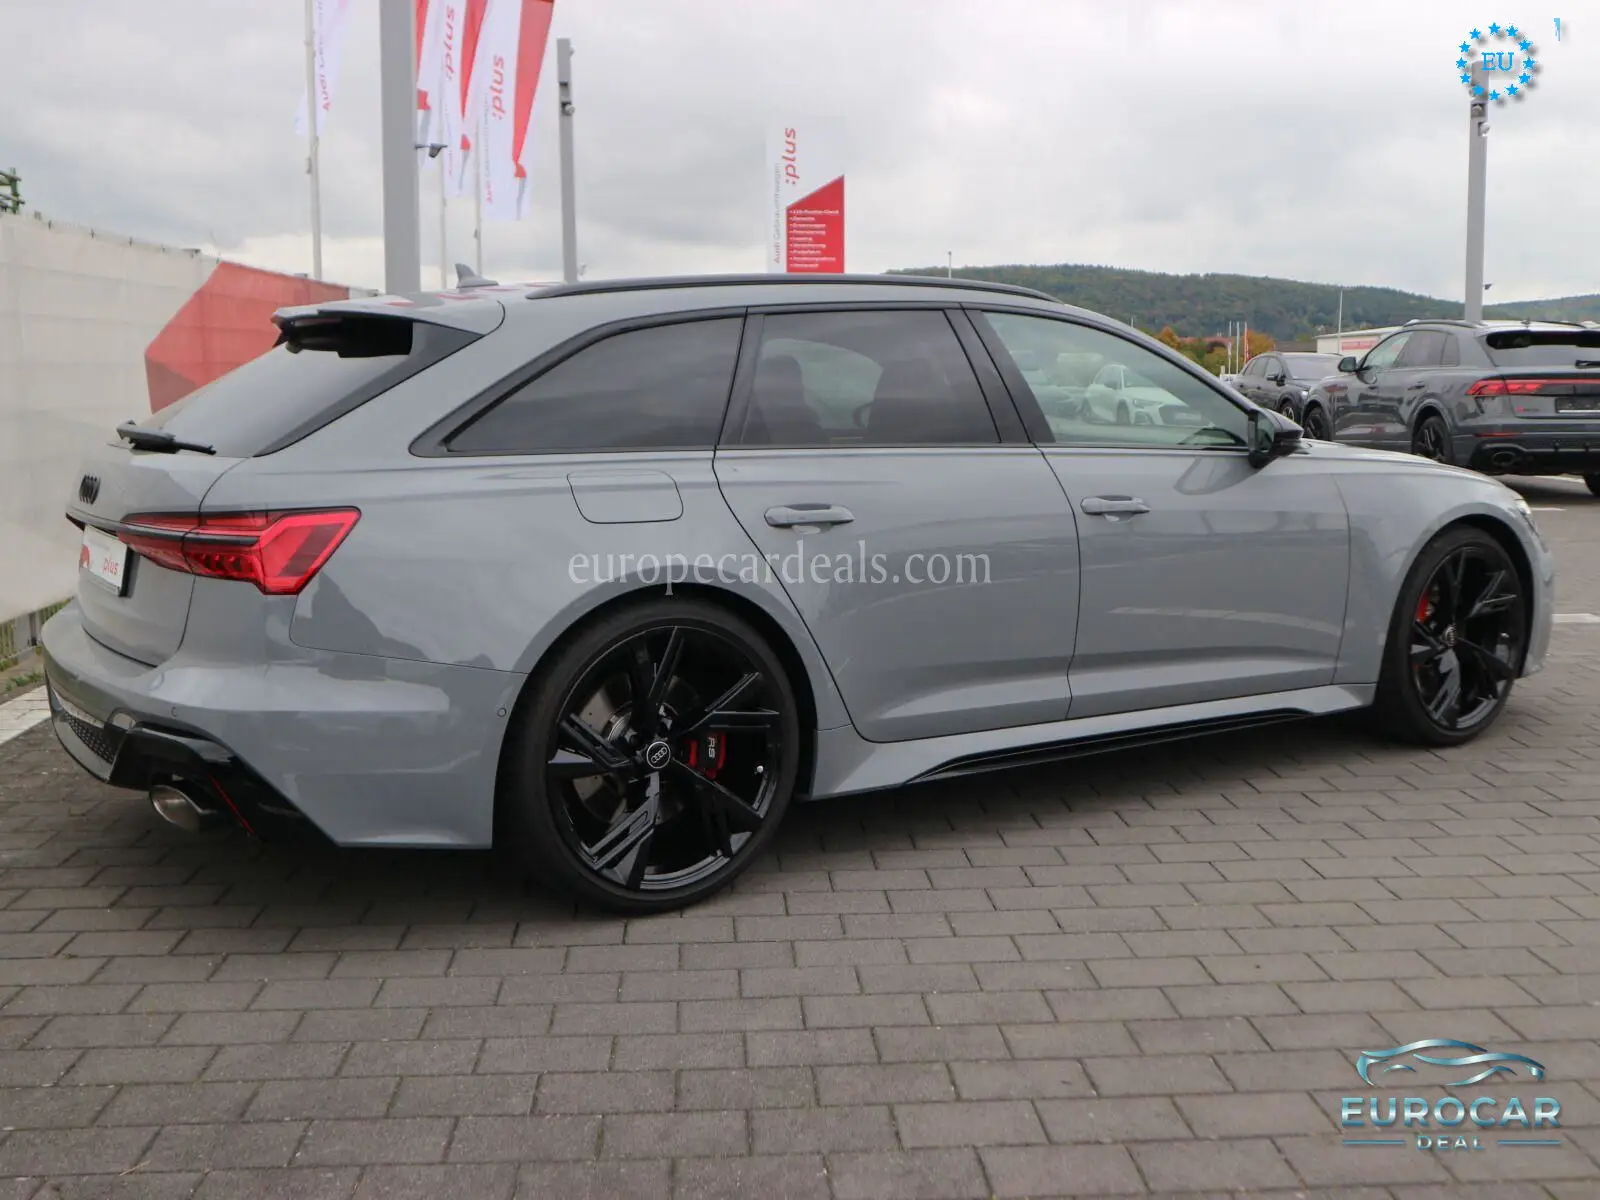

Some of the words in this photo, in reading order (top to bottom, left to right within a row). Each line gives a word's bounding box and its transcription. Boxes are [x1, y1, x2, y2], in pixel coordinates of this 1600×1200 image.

[489, 55, 506, 121] :plus
[781, 127, 800, 186] :plus
[708, 737, 717, 758] RS
